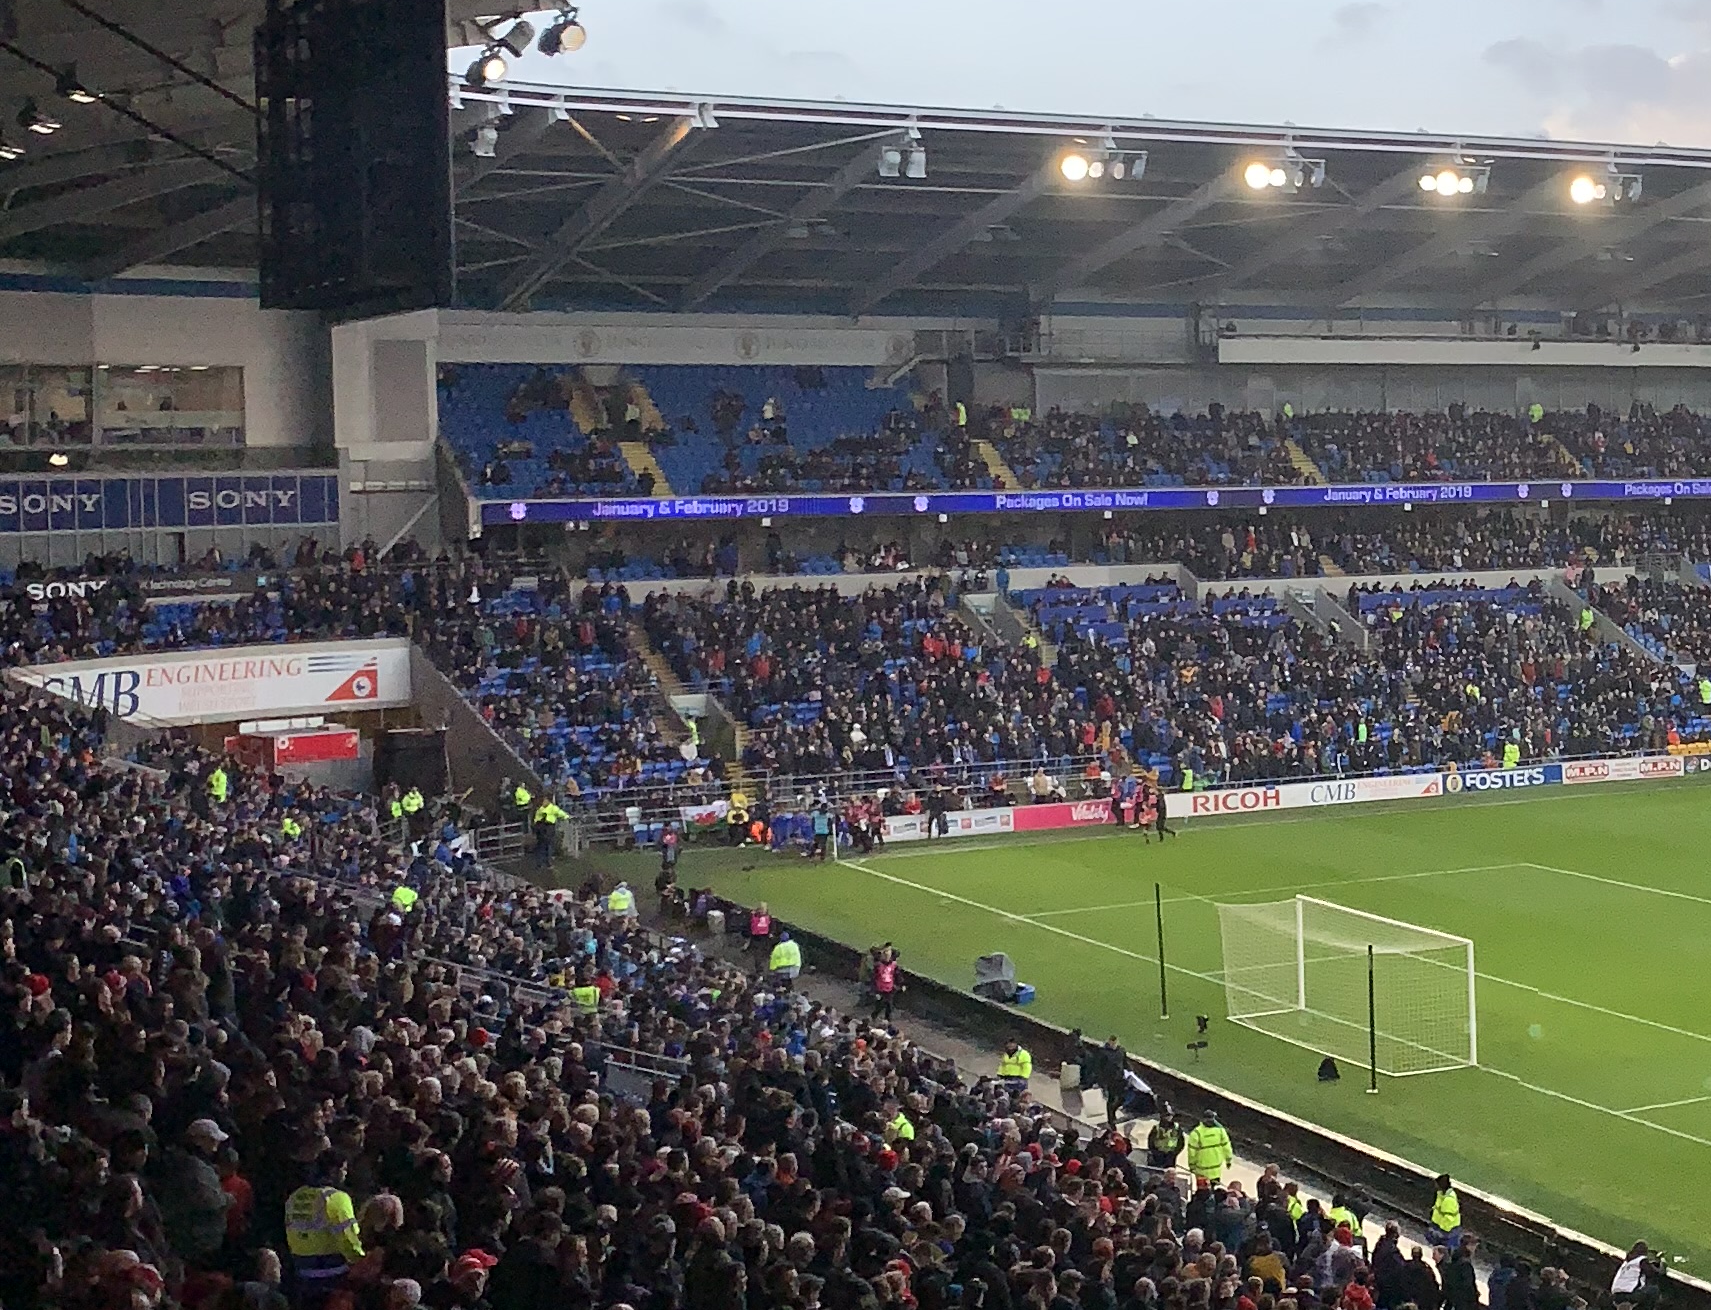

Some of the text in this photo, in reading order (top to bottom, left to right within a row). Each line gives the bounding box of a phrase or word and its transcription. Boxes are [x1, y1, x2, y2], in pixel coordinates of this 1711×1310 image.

[1324, 489, 1371, 502] January
[1386, 487, 1438, 501] February
[1440, 486, 1472, 498] 2019
[1624, 483, 1672, 496] Packages
[1674, 482, 1690, 494] On
[0, 493, 99, 514] SONY
[189, 490, 295, 509] SONY
[593, 501, 654, 518] January
[675, 499, 743, 516] February
[747, 497, 789, 513] 2019
[996, 493, 1148, 510] Packages On Sale Now!
[27, 580, 107, 599] SONY
[146, 658, 301, 687] ENGINEERING
[1193, 790, 1280, 813] RICOH
[1311, 783, 1356, 803] CMB
